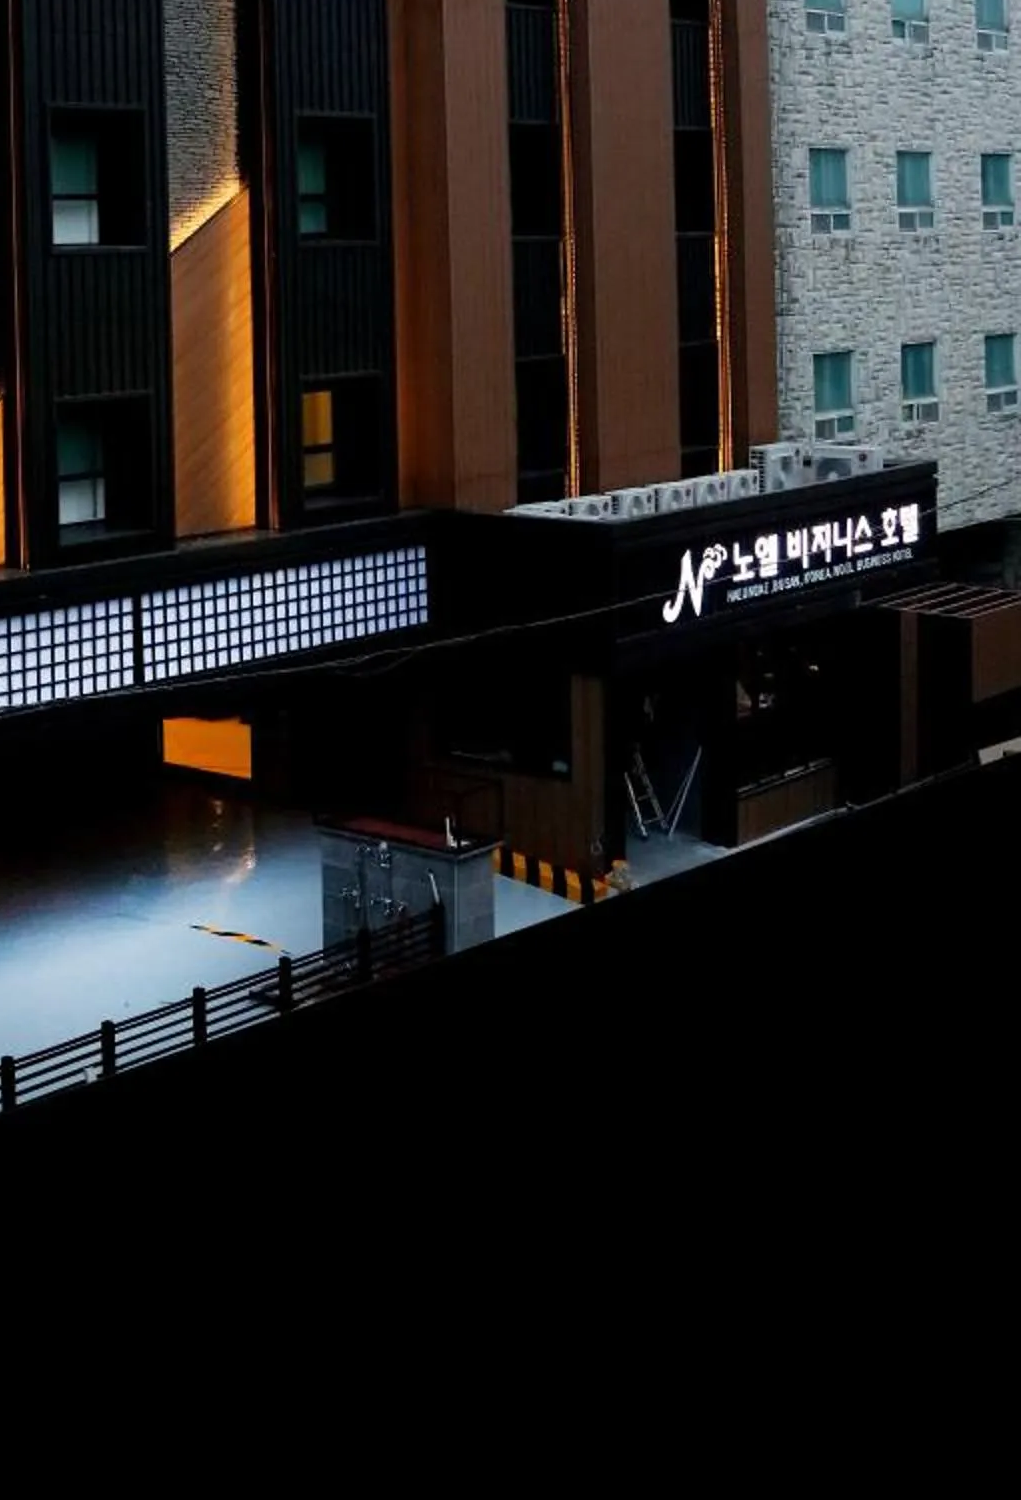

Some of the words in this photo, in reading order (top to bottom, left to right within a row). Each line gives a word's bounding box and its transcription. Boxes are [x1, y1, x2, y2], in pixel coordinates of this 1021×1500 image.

[732, 533, 778, 582] 노엘
[786, 515, 874, 569] 비지니스
[881, 503, 919, 547] 호텔
